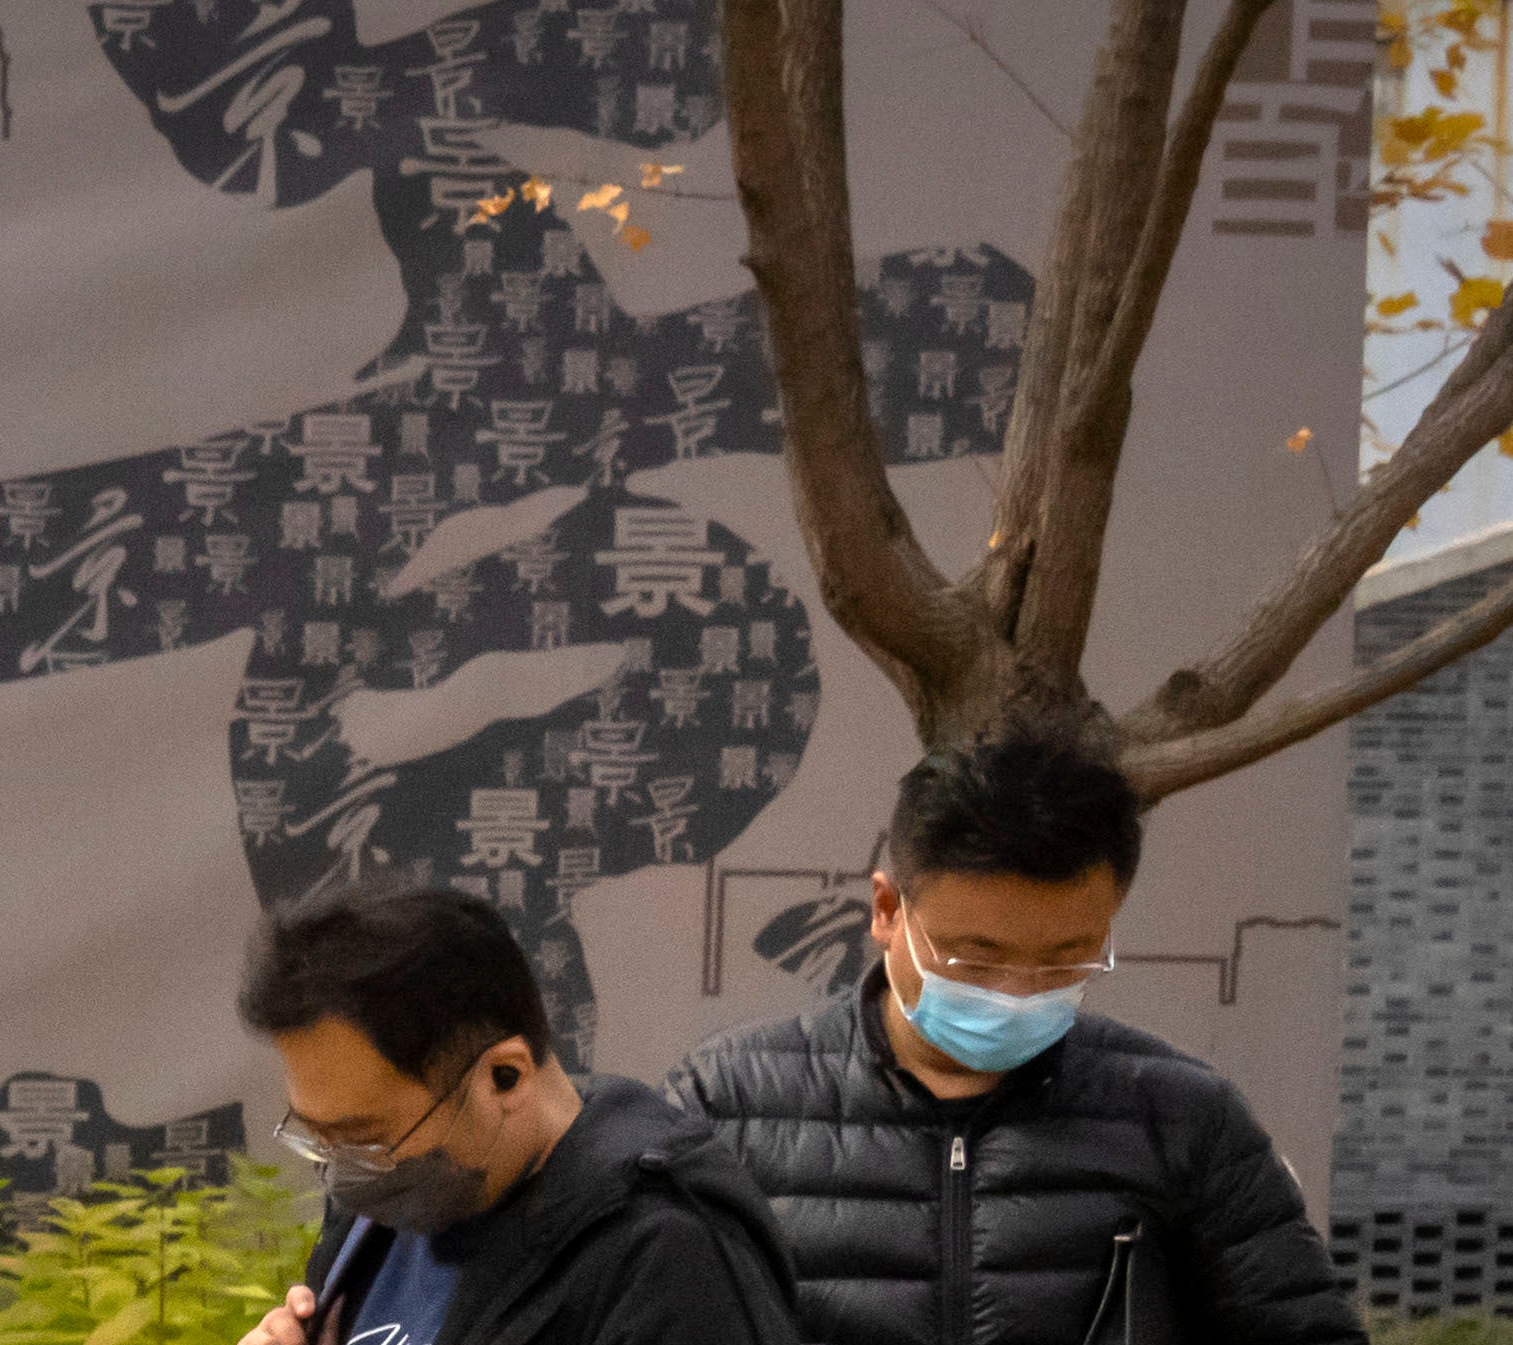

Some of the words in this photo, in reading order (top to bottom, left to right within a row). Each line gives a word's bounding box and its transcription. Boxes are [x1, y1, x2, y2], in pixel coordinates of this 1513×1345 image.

[423, 324, 505, 412] 景
[164, 439, 258, 527] 景
[289, 414, 384, 493] 景
[475, 399, 568, 487] 景
[595, 508, 726, 618] 景
[231, 676, 317, 765] 景
[570, 718, 661, 807] 景
[456, 786, 551, 867] 景
